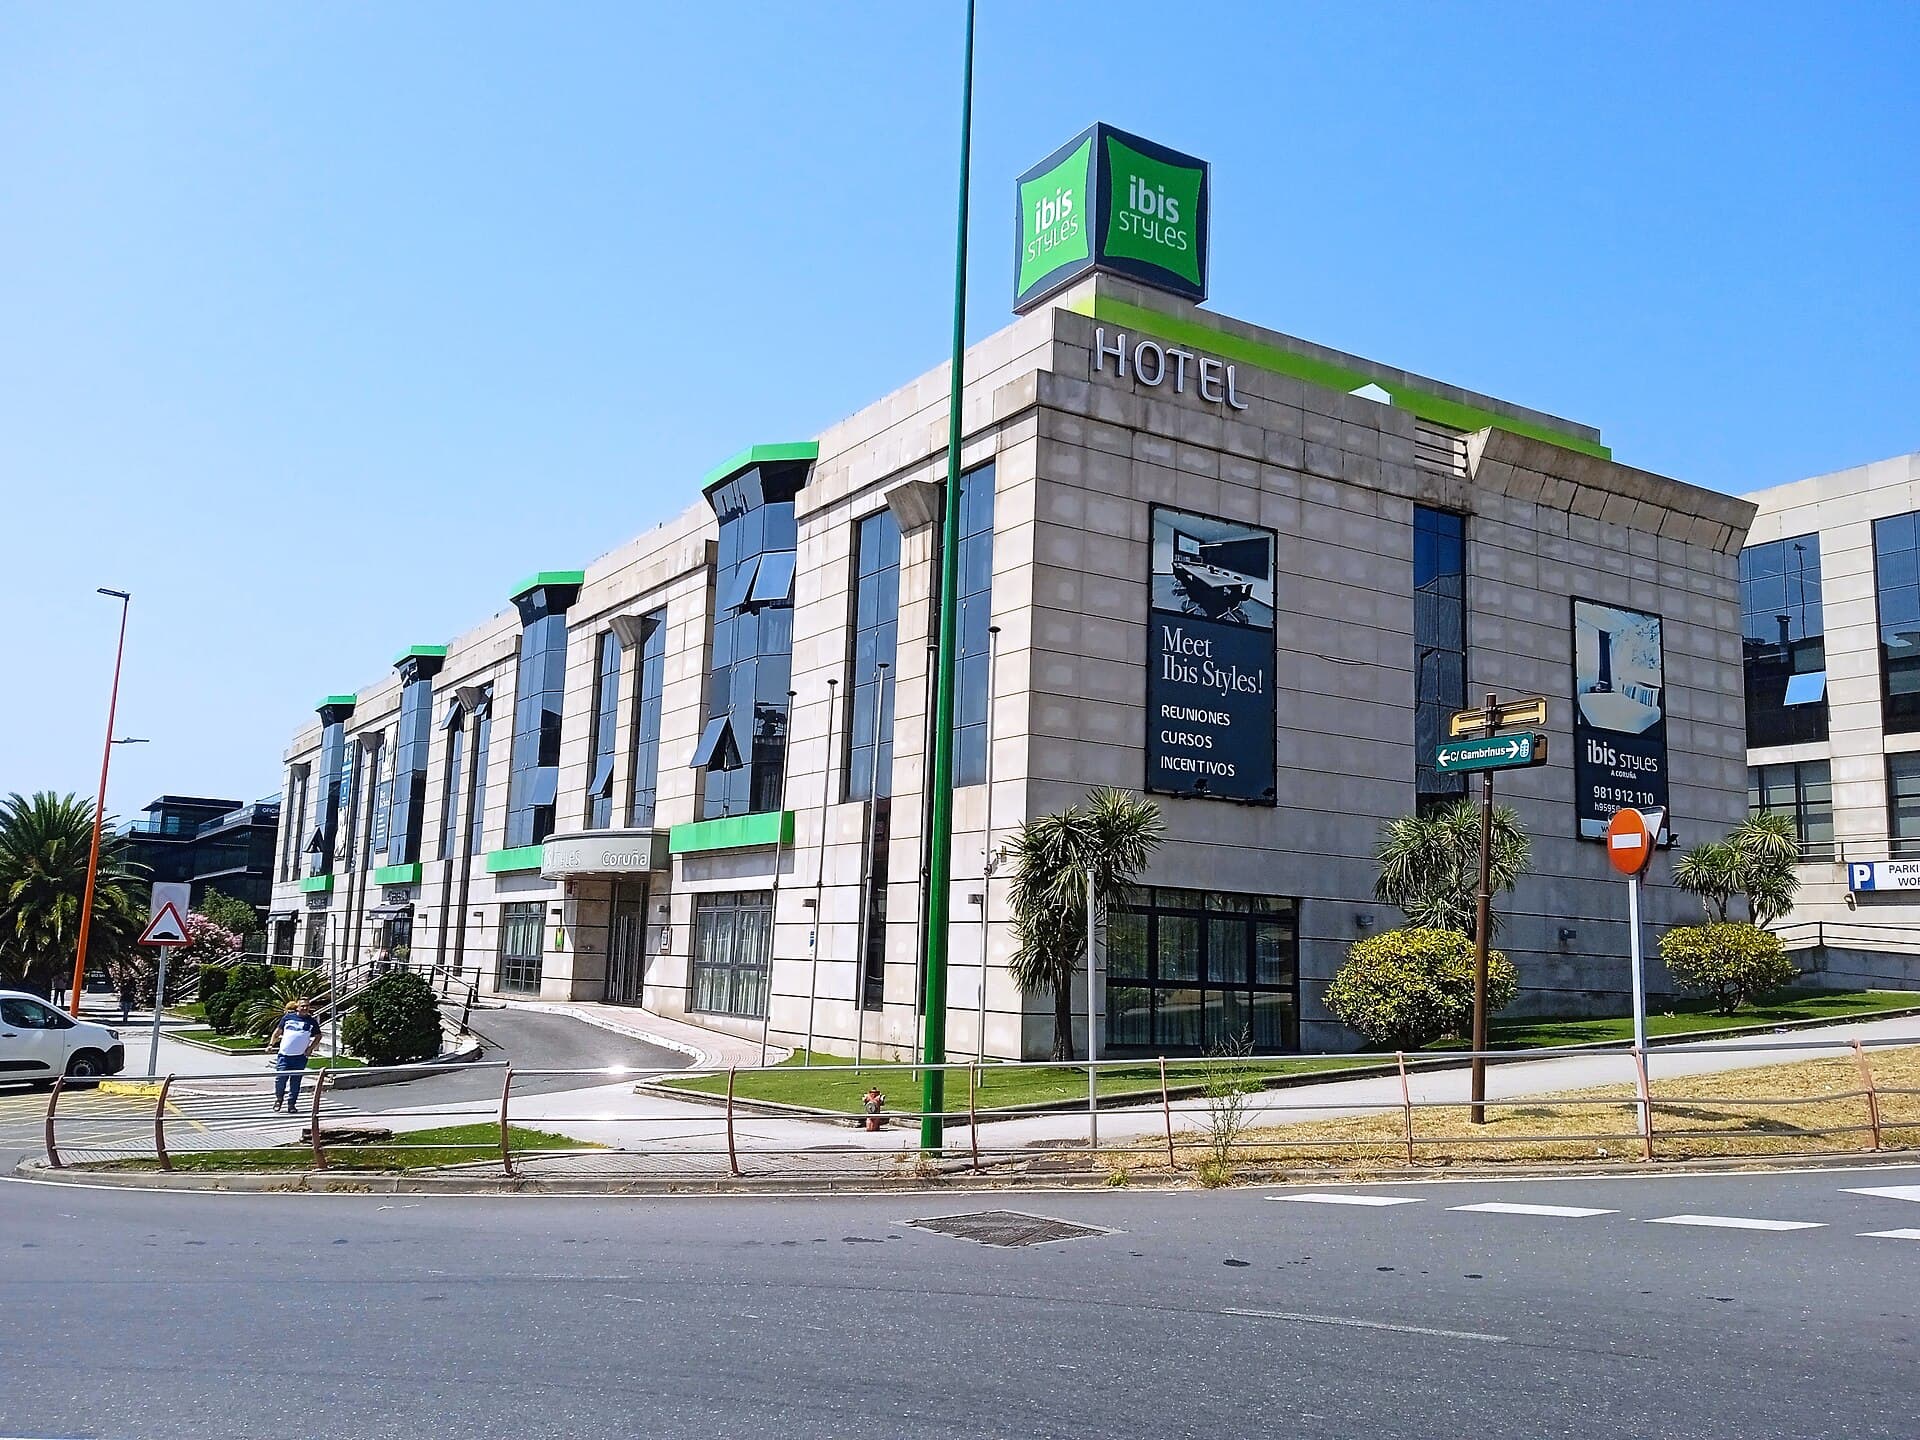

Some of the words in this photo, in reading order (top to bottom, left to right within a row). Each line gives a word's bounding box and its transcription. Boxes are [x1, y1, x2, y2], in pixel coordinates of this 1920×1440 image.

[1034, 187, 1073, 235] ibis
[1129, 174, 1180, 224] ibis
[1095, 327, 1249, 410] HOTEL
[1162, 626, 1212, 658] Meet
[1162, 654, 1198, 684] Ibis
[1202, 661, 1264, 697] Styles!
[1161, 704, 1231, 727] REUNIONES
[1161, 730, 1213, 749] CURSOS
[1450, 751, 1459, 762] C/
[1461, 747, 1506, 760] Gambrinus
[1587, 739, 1617, 767] ibis
[1160, 755, 1236, 777] INCENTIVOS
[1615, 771, 1637, 780] CORUÑA
[1593, 785, 1612, 800] 981
[1614, 789, 1633, 803] 912
[1636, 792, 1654, 805] 110
[602, 848, 648, 866] Coruña
[1853, 864, 1871, 889] P
